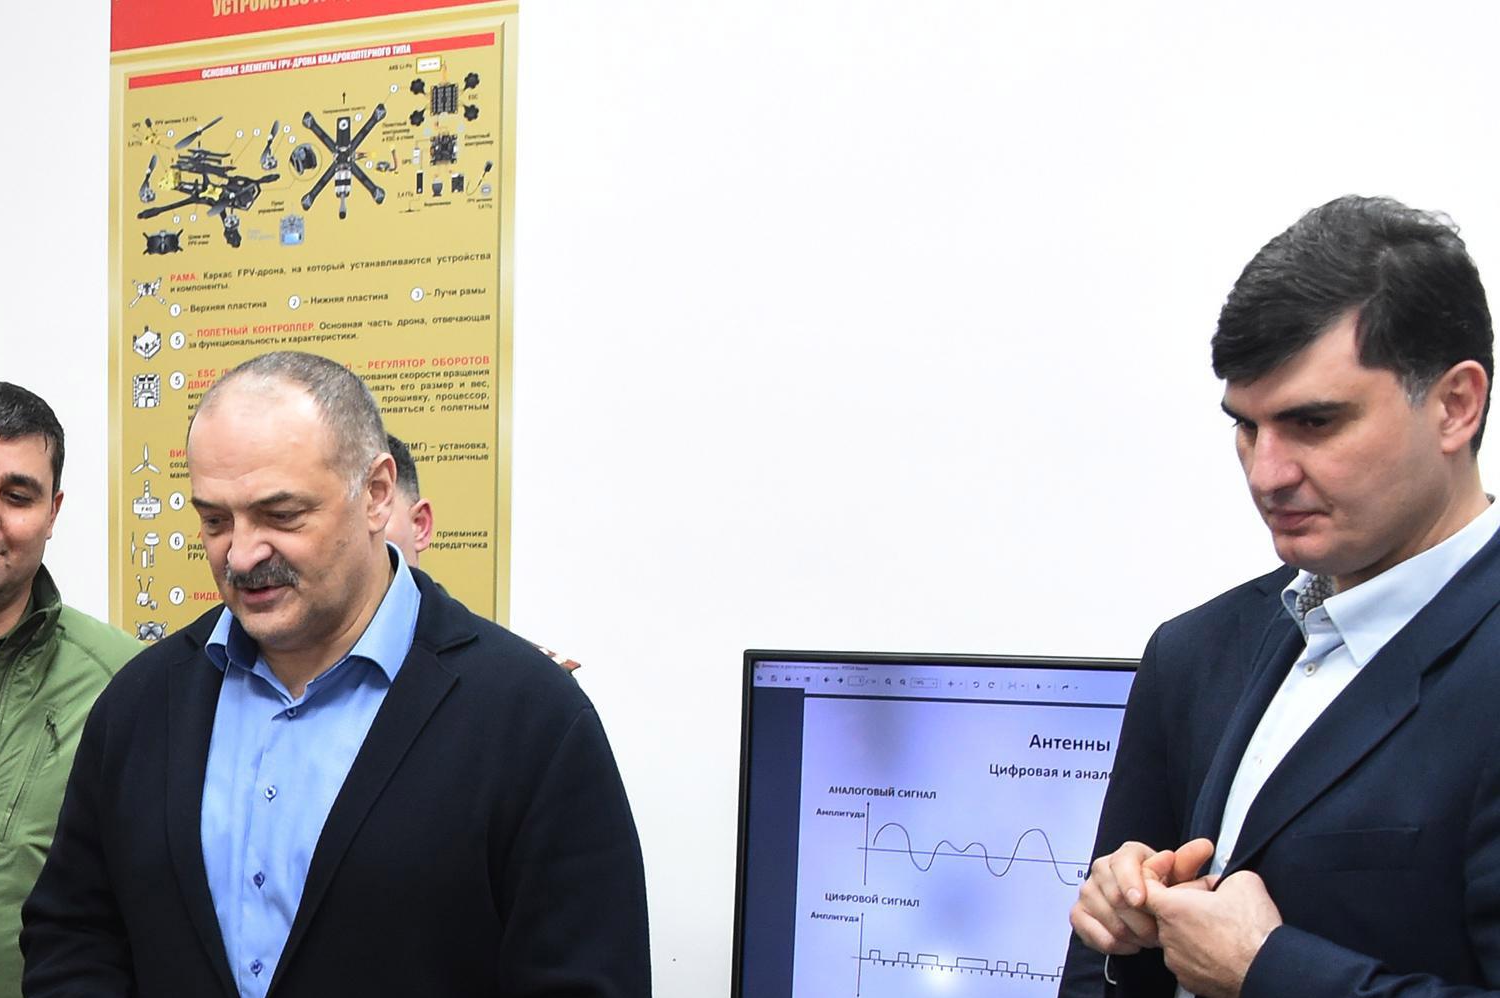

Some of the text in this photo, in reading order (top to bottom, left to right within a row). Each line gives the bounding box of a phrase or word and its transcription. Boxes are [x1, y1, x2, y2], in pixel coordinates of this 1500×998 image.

[240, 62, 277, 74] ЭЛЕМЕНТЫ
[392, 44, 411, 54] ТИПА
[203, 270, 232, 280] Каркас
[237, 267, 285, 277] FPV-дрона,
[307, 263, 345, 273] который
[350, 256, 431, 270] устанавливаются
[437, 252, 491, 264] устройства
[310, 296, 344, 305] Нижняя
[346, 293, 389, 302] пластина
[433, 288, 457, 298] Лучи
[459, 287, 486, 296] рамы
[190, 303, 225, 313] Верхняя
[227, 300, 267, 310] пластина
[196, 325, 249, 338] ПОЛЕТНЫЙ
[319, 321, 363, 330] Основная
[367, 319, 393, 328] часть
[397, 318, 428, 328] дрона,
[432, 313, 490, 325] отвечающая
[198, 336, 280, 350] функциональность
[288, 331, 359, 344] характеристики.
[368, 355, 490, 369] РЕГУЛЯТОР ОБОРОТОВ
[197, 368, 216, 377] ESC
[399, 371, 442, 381] скорости
[443, 368, 490, 378] вращения
[420, 381, 454, 391] размер
[470, 380, 490, 389] вес,
[381, 391, 490, 404] прошивку, процессор,
[440, 403, 490, 412] полетным
[438, 441, 489, 452] установка,
[436, 453, 489, 463] различные
[429, 541, 488, 549] передатчика
[1029, 734, 1110, 752] Антенны
[989, 763, 1059, 781] Цифровая
[1063, 769, 1071, 779] и
[828, 786, 937, 799] АНАЛОГОВЫЙ СИГНАЛ
[816, 808, 866, 819] Амплитуда
[825, 892, 920, 908] ЦИФРОВОЙ СИГНАЛ
[810, 911, 859, 924] Амплитуда
